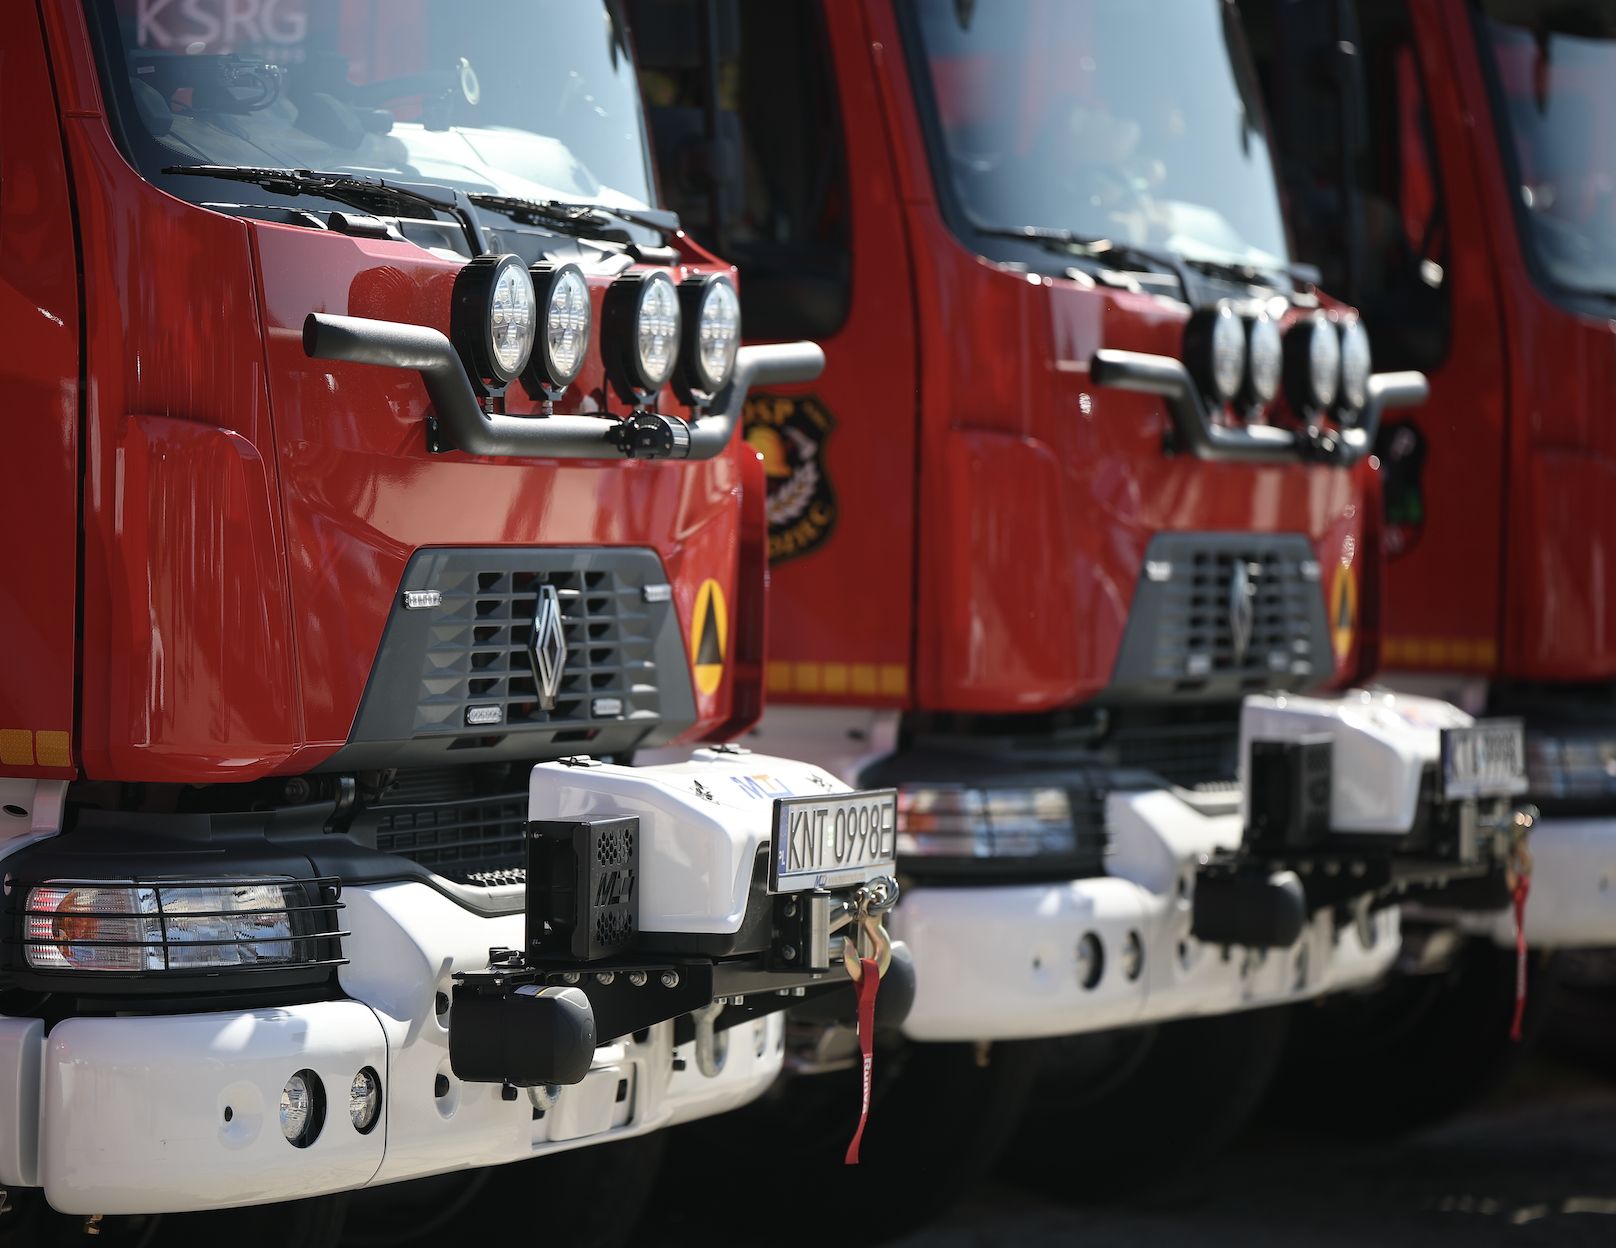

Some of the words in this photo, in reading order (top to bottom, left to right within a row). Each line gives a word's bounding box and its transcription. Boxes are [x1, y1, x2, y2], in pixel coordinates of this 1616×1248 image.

[137, 0, 307, 46] KSRG
[788, 809, 829, 870] KNT
[834, 803, 893, 863] 0998E
